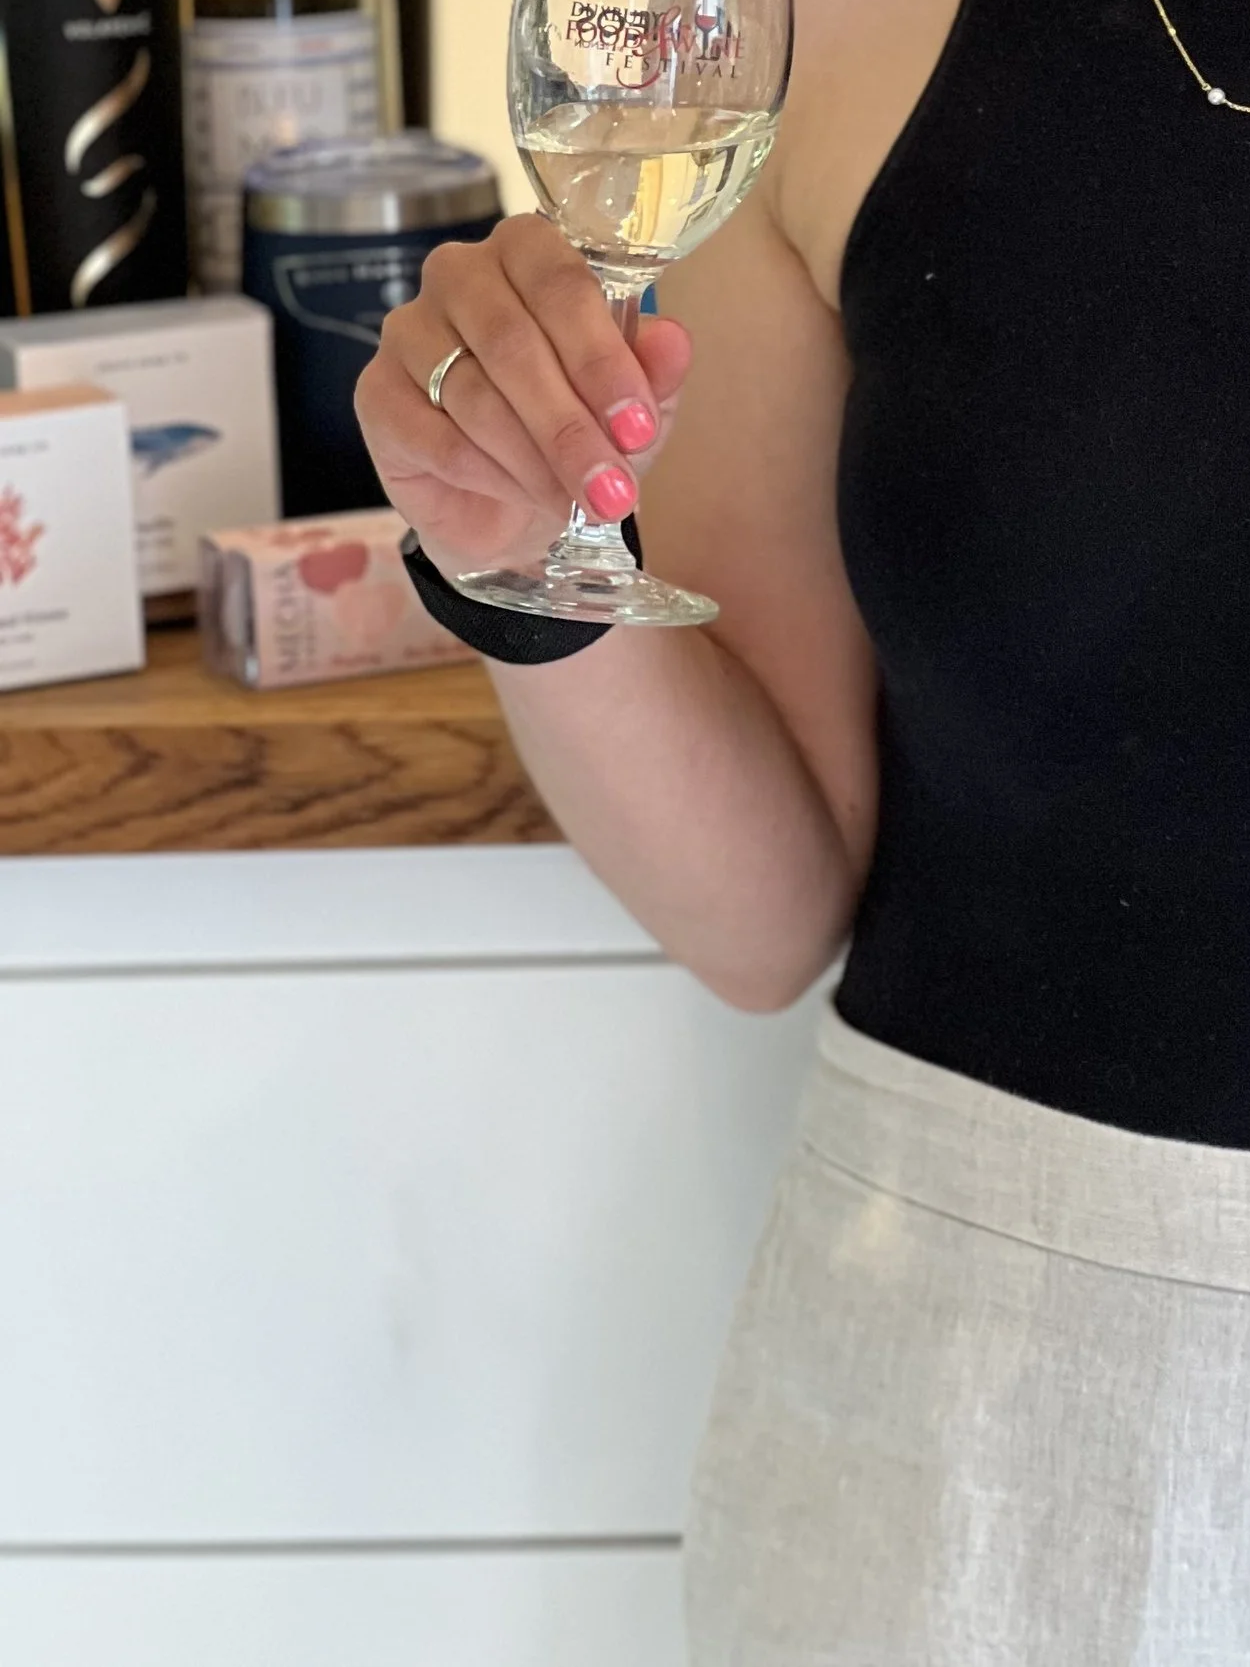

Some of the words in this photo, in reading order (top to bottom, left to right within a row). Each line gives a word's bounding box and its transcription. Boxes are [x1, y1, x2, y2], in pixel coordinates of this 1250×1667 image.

[571, 1, 665, 26] DUXBURY
[566, 20, 645, 49] FOOD
[605, 52, 740, 78] FESTIVAL
